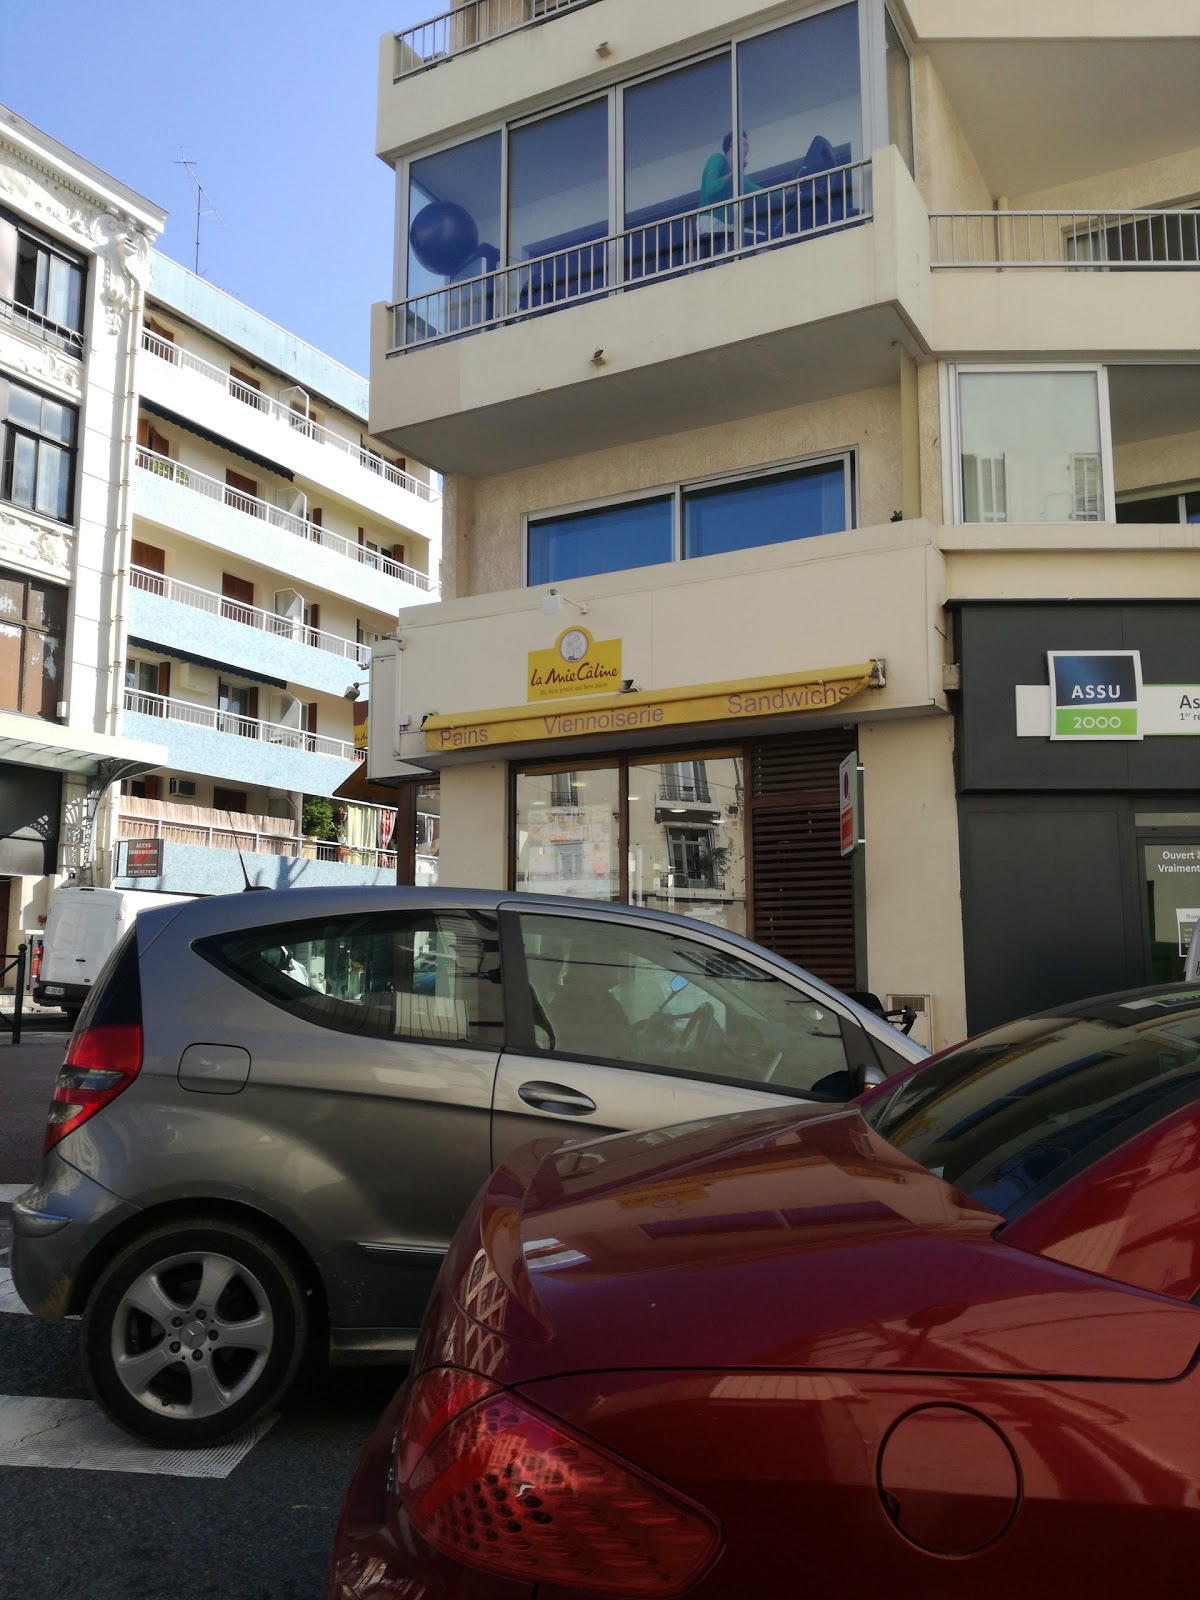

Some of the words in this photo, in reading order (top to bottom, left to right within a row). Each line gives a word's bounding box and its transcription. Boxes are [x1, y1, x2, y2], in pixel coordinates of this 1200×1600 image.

[530, 668, 543, 687] la
[545, 668, 575, 685] Mie
[576, 661, 619, 681] Câline
[1071, 685, 1121, 699] ASSU
[440, 727, 489, 748] Pains
[543, 705, 664, 736] Viennoiserie
[727, 683, 850, 715] Sandwichs
[1073, 716, 1122, 729] 2000
[1162, 850, 1195, 860] Ouvert
[1157, 863, 1200, 873] Vraiment
